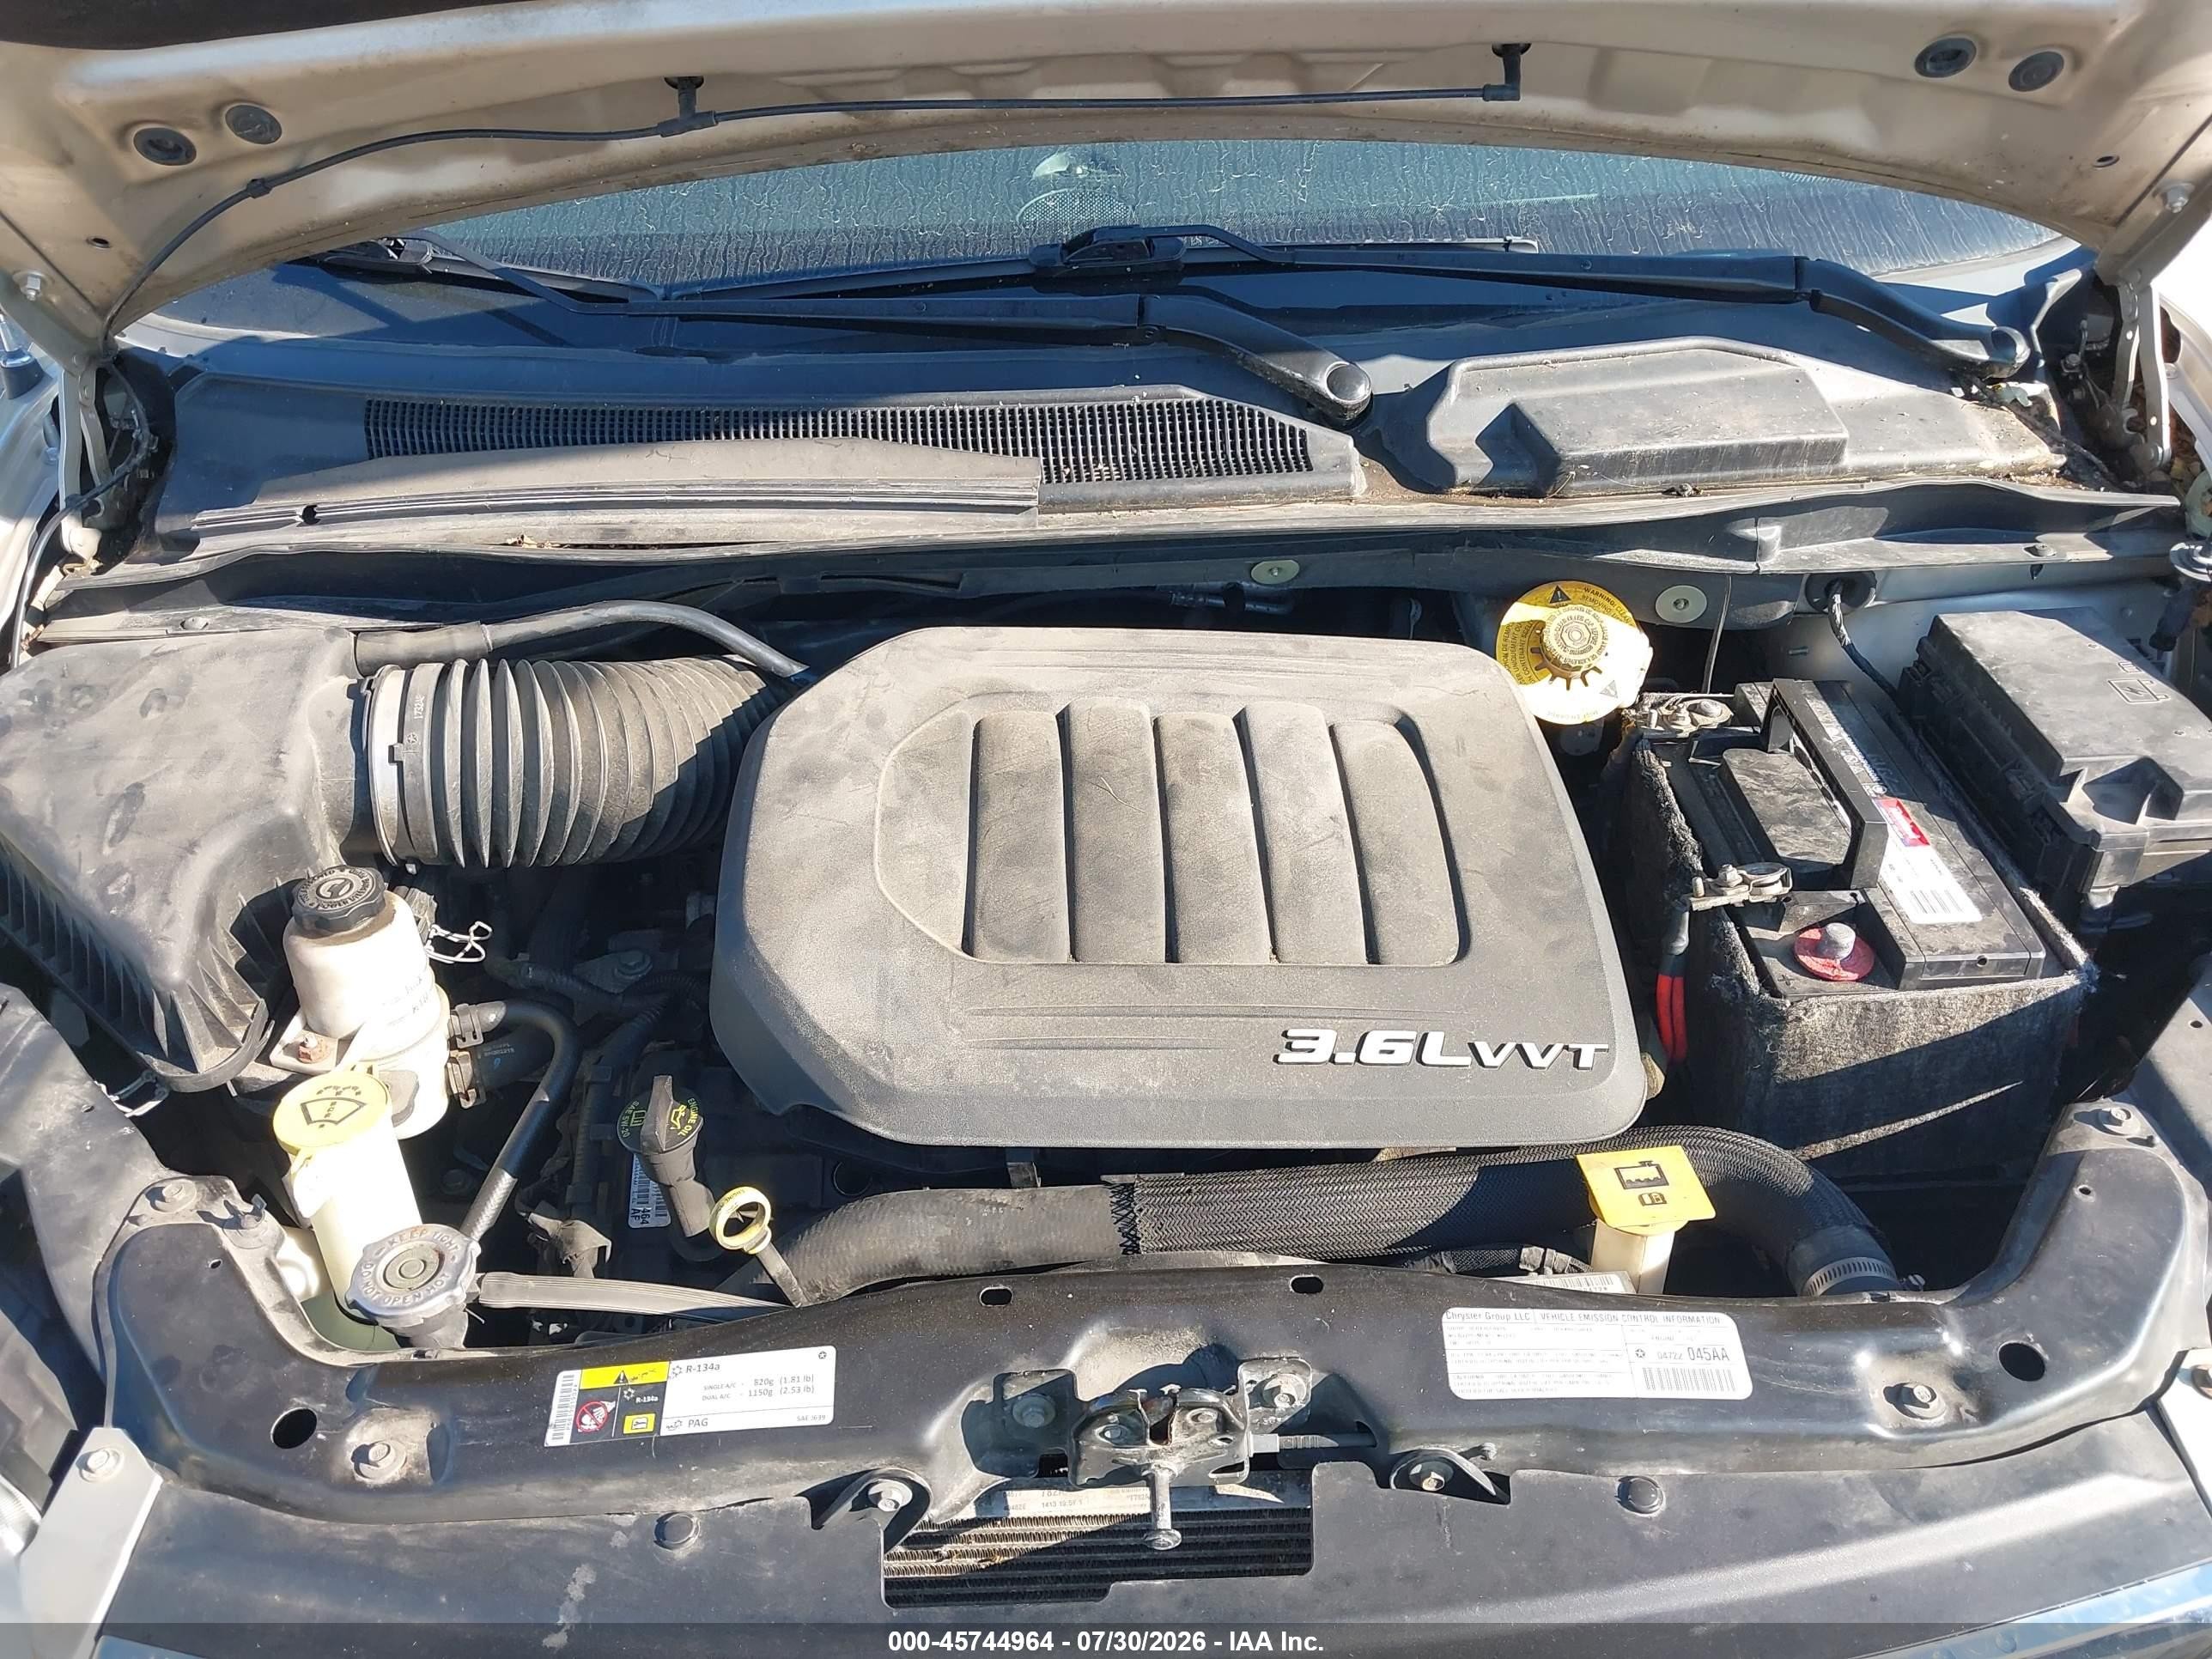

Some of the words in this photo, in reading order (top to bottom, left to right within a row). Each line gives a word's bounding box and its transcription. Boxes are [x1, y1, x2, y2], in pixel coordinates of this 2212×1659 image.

[1583, 587, 1616, 608] WARNING:
[625, 1100, 640, 1115] SAE
[688, 1097, 699, 1124] ENGINE
[679, 1125, 692, 1136] OIL
[630, 1208, 641, 1220] AF
[388, 1227, 427, 1248] KEEP
[433, 1231, 460, 1250] TIGHT
[362, 1262, 374, 1277] DO
[362, 1280, 381, 1300] NOT
[425, 1272, 449, 1295] HOT
[384, 1291, 422, 1305] OPEN
[1446, 1310, 1481, 1322] Chrysler
[1486, 1312, 1510, 1322] Group
[1540, 1313, 1574, 1322] VEHICLE
[1578, 1314, 1619, 1322] EMISSION
[1621, 1315, 1659, 1323] CONTROL
[1663, 1316, 1721, 1324] INFORMATION
[1687, 1347, 1730, 1361] 045AA
[686, 1363, 720, 1374] R-134a
[748, 1388, 773, 1397] 1150g
[780, 1386, 801, 1395] (2.53
[803, 1384, 814, 1394] lb)
[688, 1418, 708, 1427] PAG
